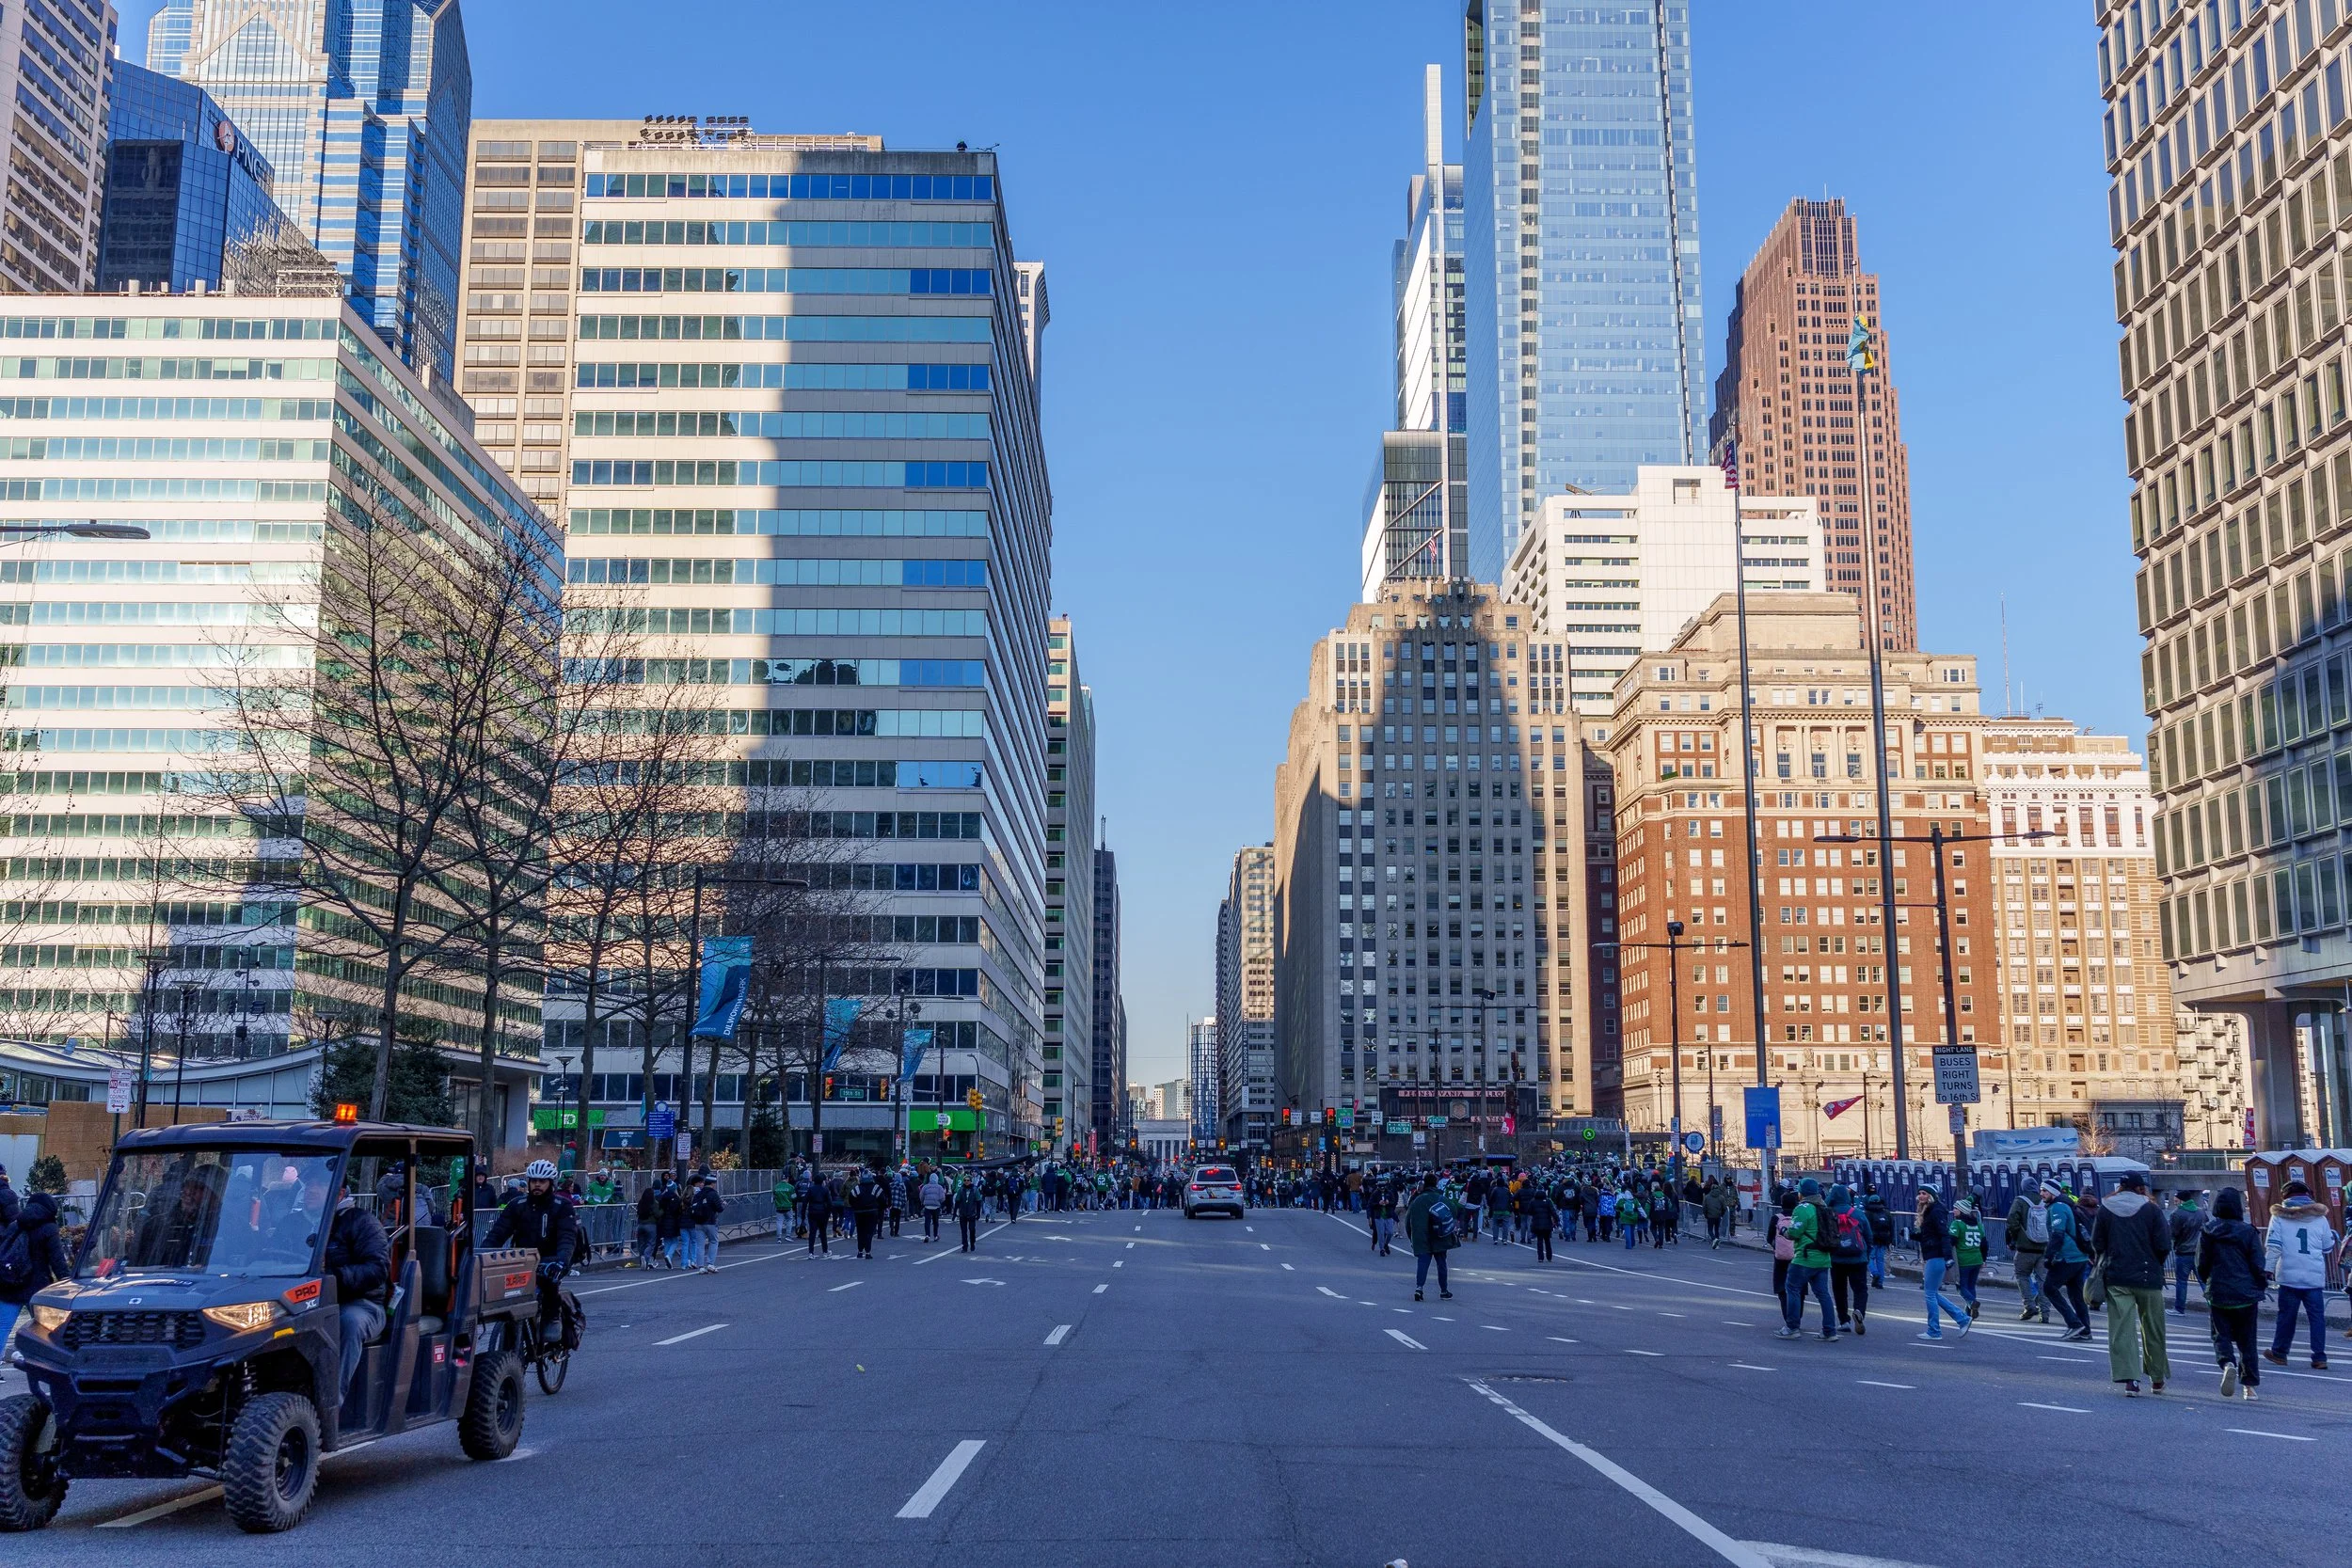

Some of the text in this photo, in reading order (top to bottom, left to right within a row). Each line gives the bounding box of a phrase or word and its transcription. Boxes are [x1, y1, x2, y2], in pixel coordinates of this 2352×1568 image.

[237, 136, 262, 182] PNC
[723, 977, 747, 1036] DILWORTH PARK
[1940, 1057, 1971, 1067] BUSES
[1942, 1070, 1970, 1080] RIGHT
[1942, 1082, 1973, 1091] TURNS
[1936, 1093, 1979, 1102] To 16th St
[1097, 1178, 1106, 1186] 62
[1964, 1231, 1981, 1247] 55
[2296, 1227, 2311, 1256] 1
[294, 1284, 318, 1299] PRO
[305, 1299, 317, 1309] XC
